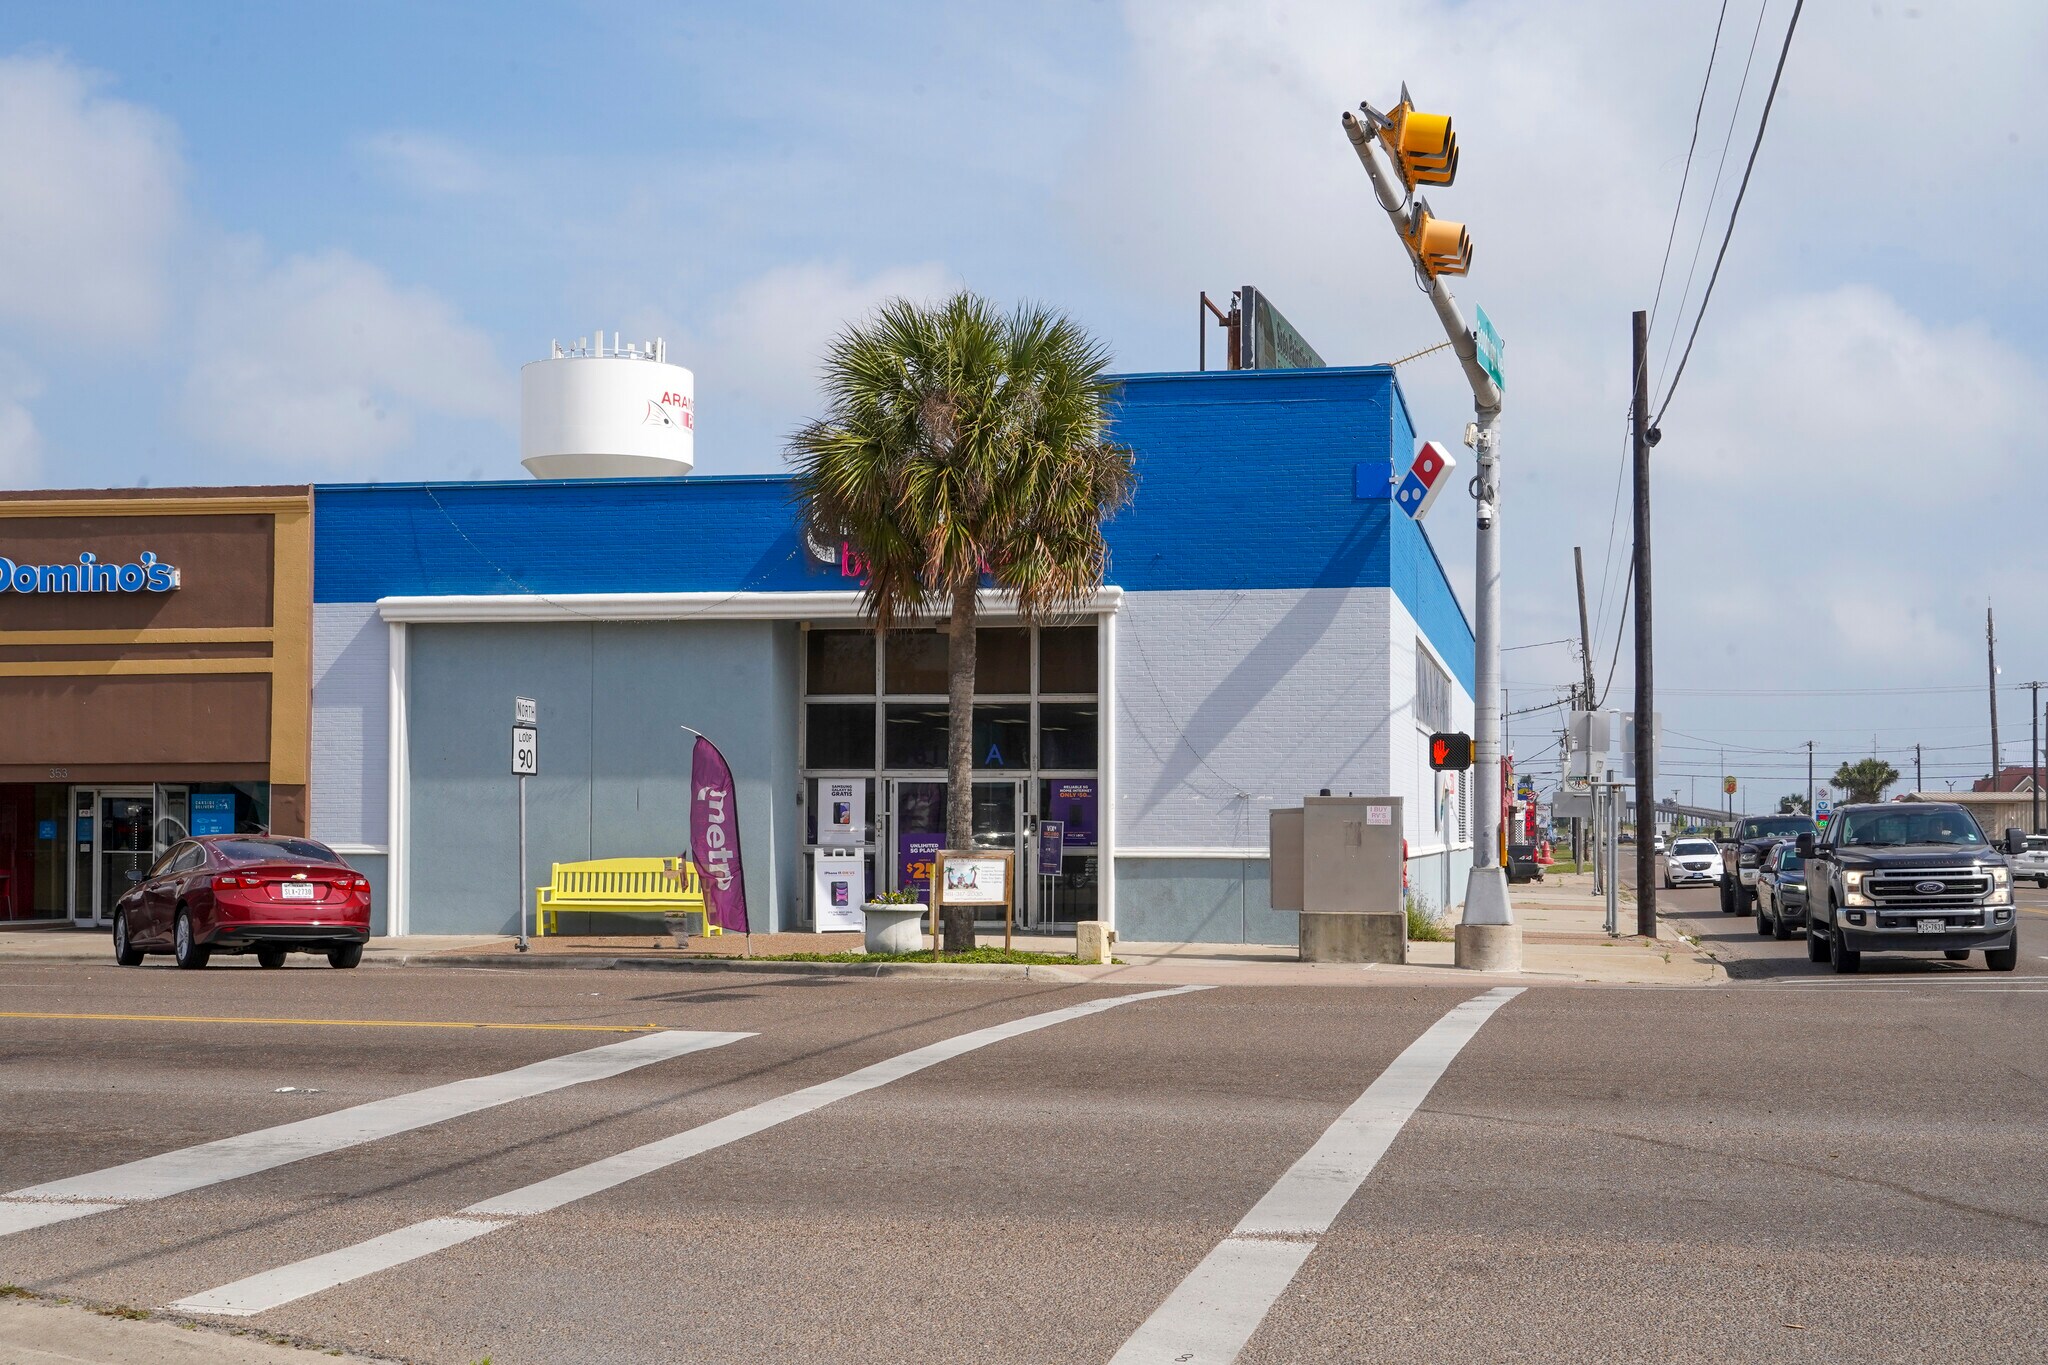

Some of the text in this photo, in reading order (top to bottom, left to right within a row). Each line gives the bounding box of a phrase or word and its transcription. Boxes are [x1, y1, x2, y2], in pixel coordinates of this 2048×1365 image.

[516, 701, 535, 719] NORTH
[518, 732, 532, 743] LOOP
[518, 748, 533, 769] 90
[49, 768, 68, 779] 353
[697, 786, 734, 891] metro
[1921, 884, 1938, 892] Ford
